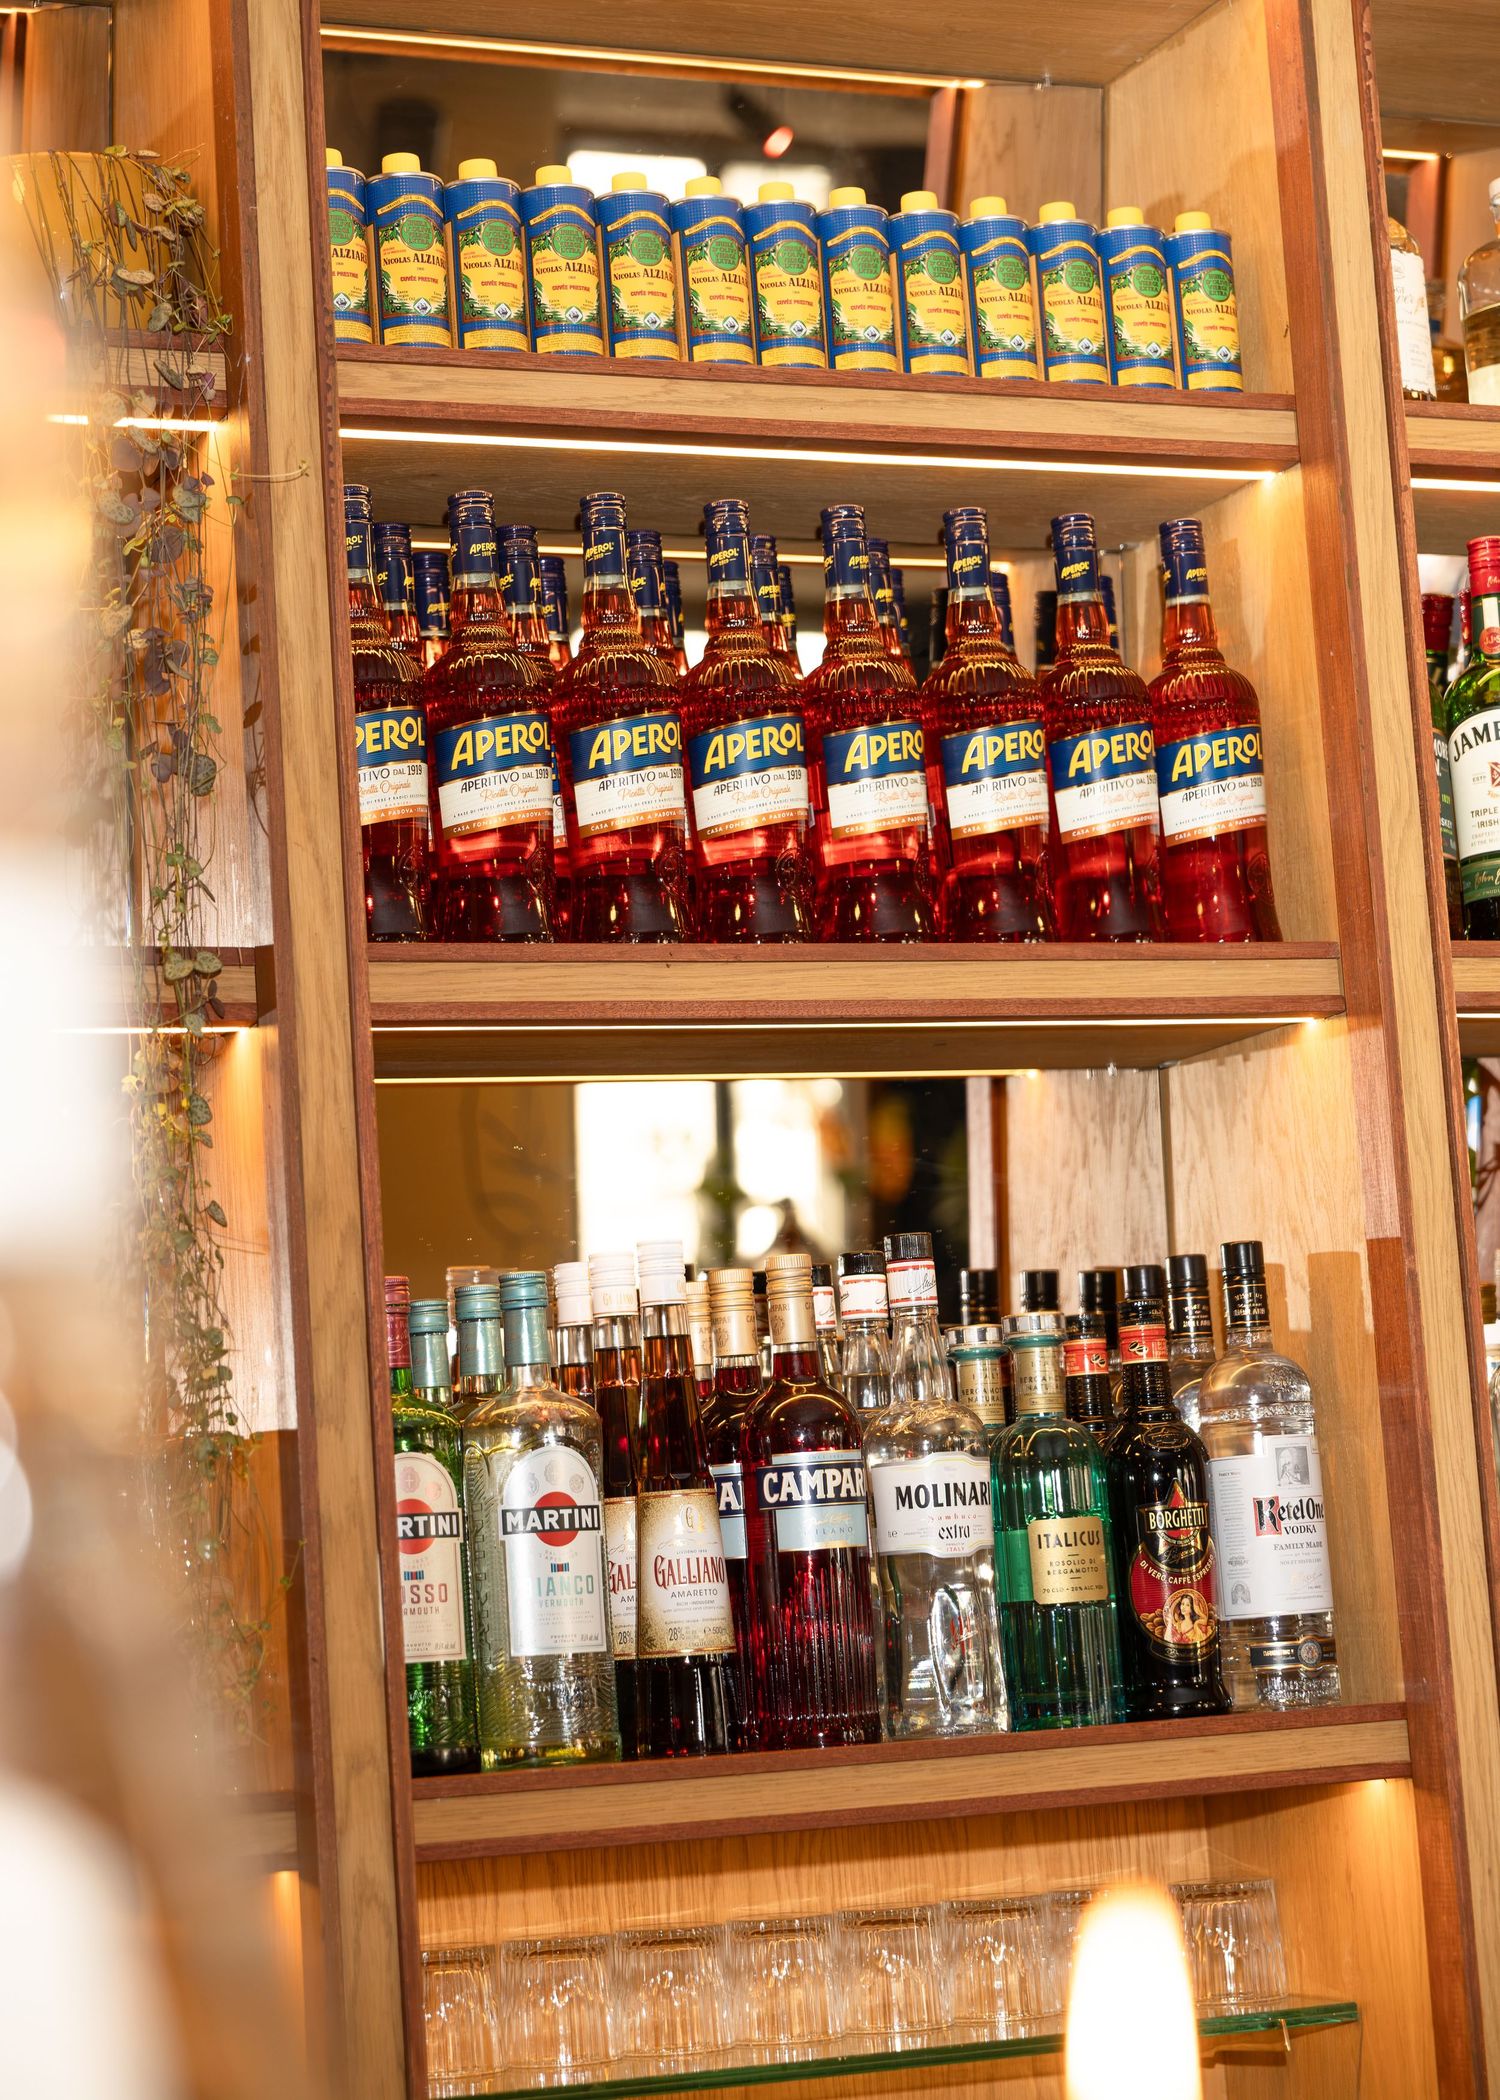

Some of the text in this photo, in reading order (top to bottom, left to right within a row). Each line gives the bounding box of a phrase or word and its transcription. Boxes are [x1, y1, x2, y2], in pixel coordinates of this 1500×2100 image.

[383, 256, 410, 267] NICOLAS
[463, 261, 492, 271] NICOLAS
[535, 265, 562, 275] NICOLAS
[613, 271, 640, 281] NICOLAS
[691, 276, 719, 285] NICOLAS
[760, 281, 787, 290] NICOLAS
[833, 288, 860, 296] NICOLAS
[909, 289, 936, 297] NICOLAS
[979, 295, 1006, 304] NICOLAS
[1047, 299, 1074, 307] NICOLAS
[1116, 303, 1142, 311] NICOLAS
[1186, 307, 1212, 315] NICOLAS
[585, 542, 614, 560] APEROL
[709, 548, 739, 566] APEROL
[953, 555, 982, 573] APEROL
[1061, 562, 1090, 579] APEROL
[450, 721, 551, 771] APEROL
[588, 721, 683, 770] APEROL
[703, 722, 805, 775] APEROL
[1171, 732, 1263, 783] APEROL
[393, 764, 423, 776] DAL 1919
[460, 768, 549, 794] APERITIVO DAL 1919
[598, 771, 656, 793] APERITIVO
[658, 771, 670, 779] DAL
[713, 769, 802, 797] APERITIVO DAL 1919
[1079, 778, 1135, 799] APERITIVO
[1181, 781, 1237, 804] APERITIVO
[1470, 805, 1499, 819] TRIPLE
[453, 825, 470, 833] CASA
[517, 812, 541, 820] PADOVA
[590, 823, 609, 832] CASA
[706, 827, 724, 836] CASA
[768, 812, 794, 820] PADOVA
[844, 826, 865, 834] CASA
[1071, 828, 1090, 837] CASA
[1174, 832, 1191, 841] CASA
[894, 1481, 991, 1511] MOLINARI
[506, 1507, 599, 1533] MARTINI
[1148, 1507, 1205, 1530] BORGHETTI
[1255, 1498, 1305, 1533] Ketel
[804, 1526, 853, 1536] ILANO
[938, 1523, 970, 1540] extra
[1284, 1524, 1317, 1535] VODKA
[1037, 1529, 1100, 1550] ITALICUS
[1273, 1542, 1304, 1551] FAMILY
[1050, 1558, 1086, 1567] ROSOLIO
[1139, 1554, 1215, 1585] DI VERO CAFFÈ ESPRESSO
[653, 1554, 726, 1590] GALLIANO
[1047, 1566, 1099, 1576] BERGAMOTTO
[537, 1574, 595, 1598] IANCO
[670, 1588, 718, 1599] AMARETTO
[538, 1597, 584, 1608] VERMOUTH
[618, 1630, 634, 1645] 28%
[668, 1626, 685, 1641] 28%
